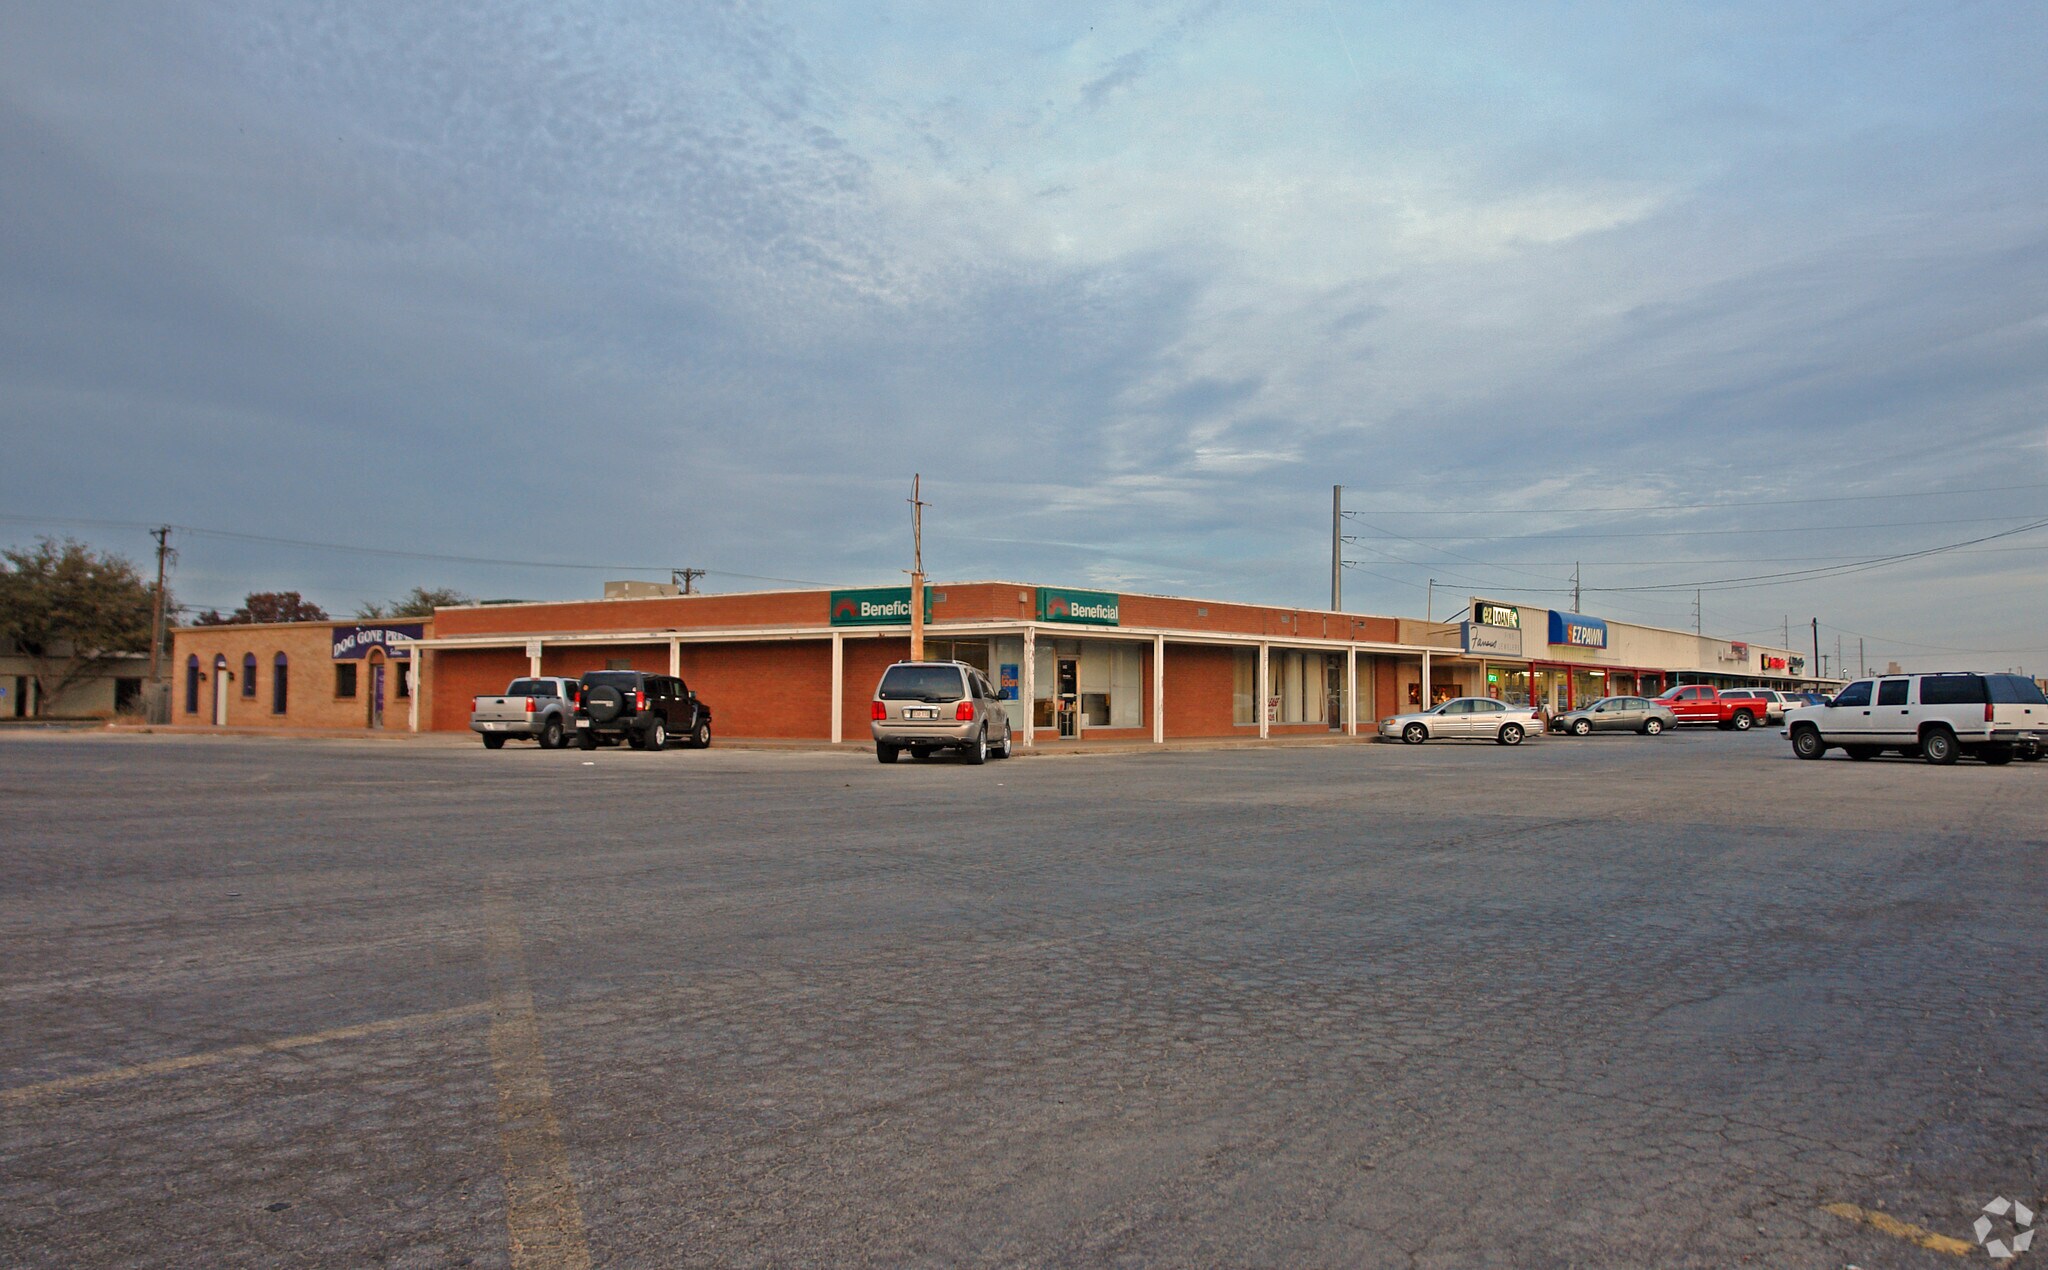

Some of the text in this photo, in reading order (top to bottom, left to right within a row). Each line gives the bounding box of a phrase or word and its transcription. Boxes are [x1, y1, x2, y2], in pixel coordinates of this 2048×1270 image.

[861, 601, 912, 616] Benefici
[1071, 602, 1118, 619] Beneficial
[334, 635, 355, 657] DOG
[357, 629, 383, 644] GONE
[1471, 626, 1497, 649] Famous
